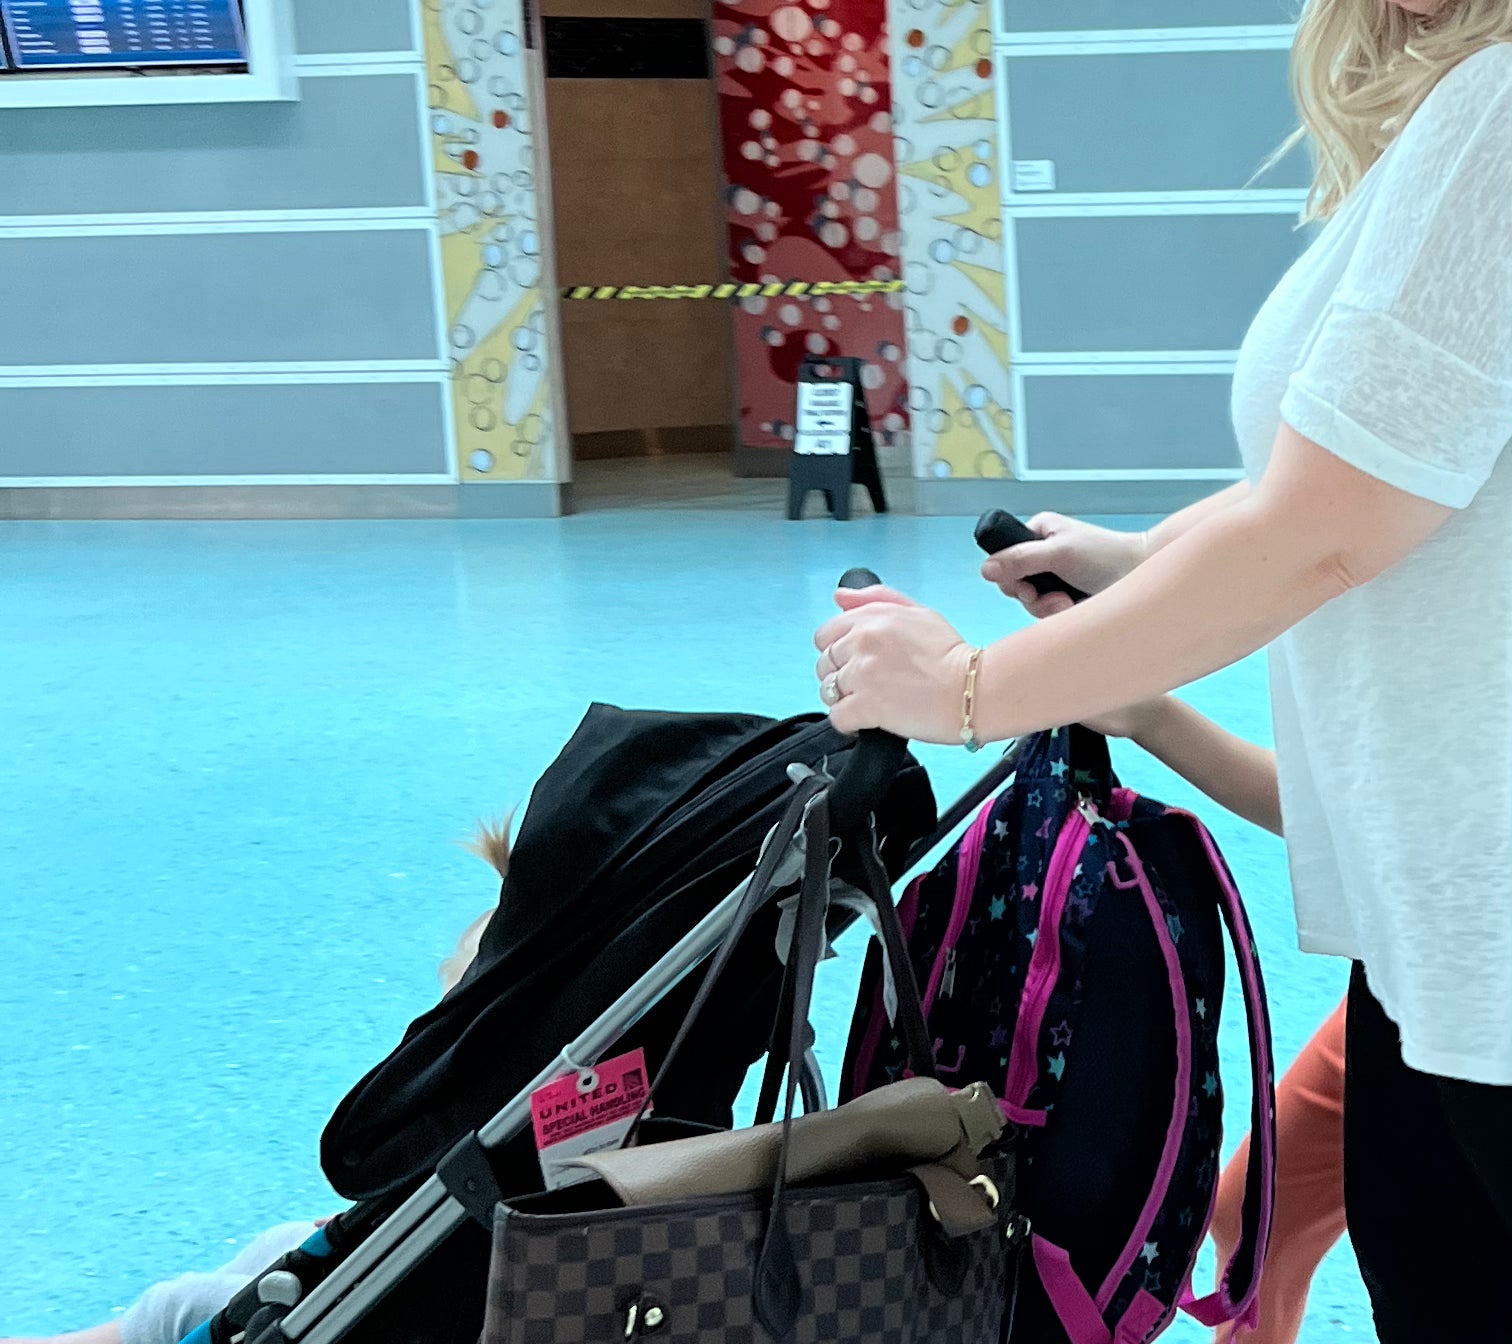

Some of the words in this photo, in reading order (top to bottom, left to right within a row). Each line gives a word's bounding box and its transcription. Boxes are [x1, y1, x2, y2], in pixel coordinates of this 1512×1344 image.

[540, 1083, 617, 1119] UNITED
[542, 1110, 588, 1135] SPECIAL
[589, 1086, 646, 1116] HANDLING
